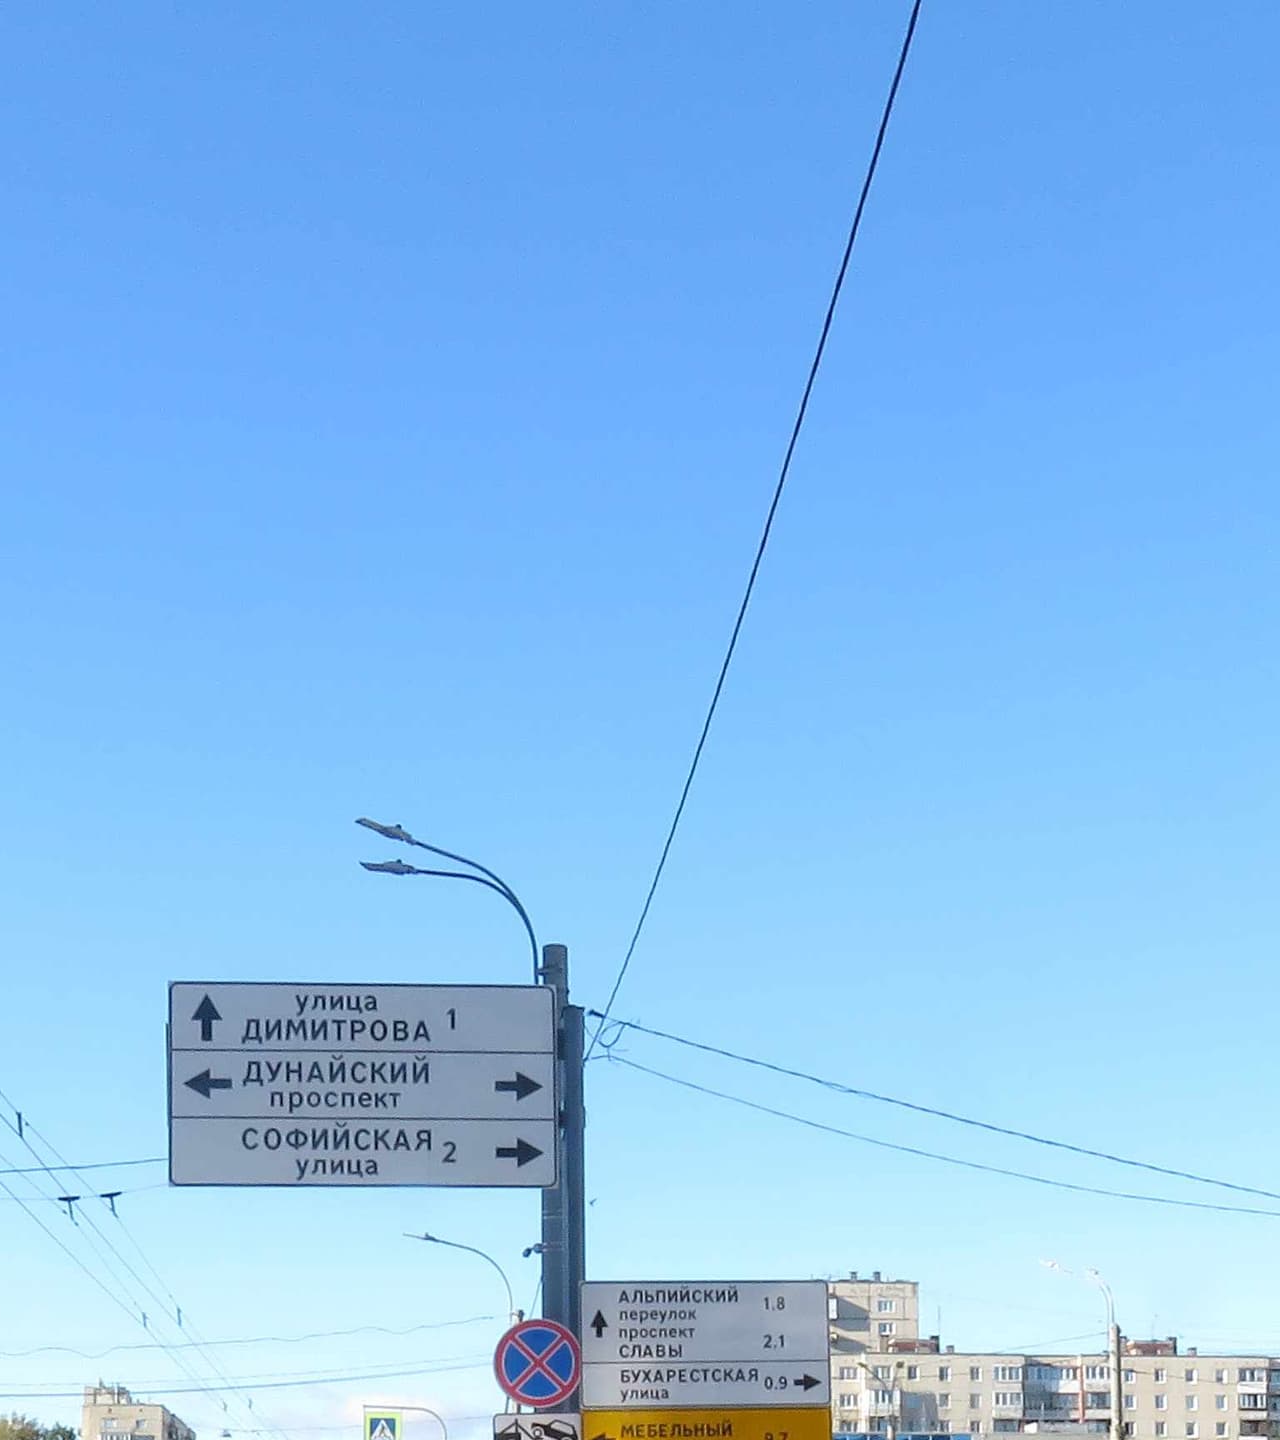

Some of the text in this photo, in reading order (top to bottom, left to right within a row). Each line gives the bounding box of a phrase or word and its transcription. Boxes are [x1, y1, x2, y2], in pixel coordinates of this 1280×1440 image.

[295, 994, 378, 1016] улица
[241, 1008, 456, 1045] ДИМИТРОВА 1
[242, 1054, 431, 1087] ДУНАЙСКИЙ
[269, 1090, 402, 1113] проспект
[241, 1122, 457, 1163] СОФИЙСКАЯ 2
[295, 1158, 379, 1181] улица
[618, 1285, 786, 1311] АЛЬПИЙСКИЙ 1.8
[619, 1309, 697, 1323] переулок
[618, 1327, 785, 1349] проспект 2.1
[618, 1343, 683, 1359] СЛАВЫ
[620, 1367, 788, 1390] БУХАРЕСТСКАЯ 0.9
[620, 1388, 670, 1402] улица
[621, 1420, 733, 1439] МЕБЕЛЬНЫЙ
